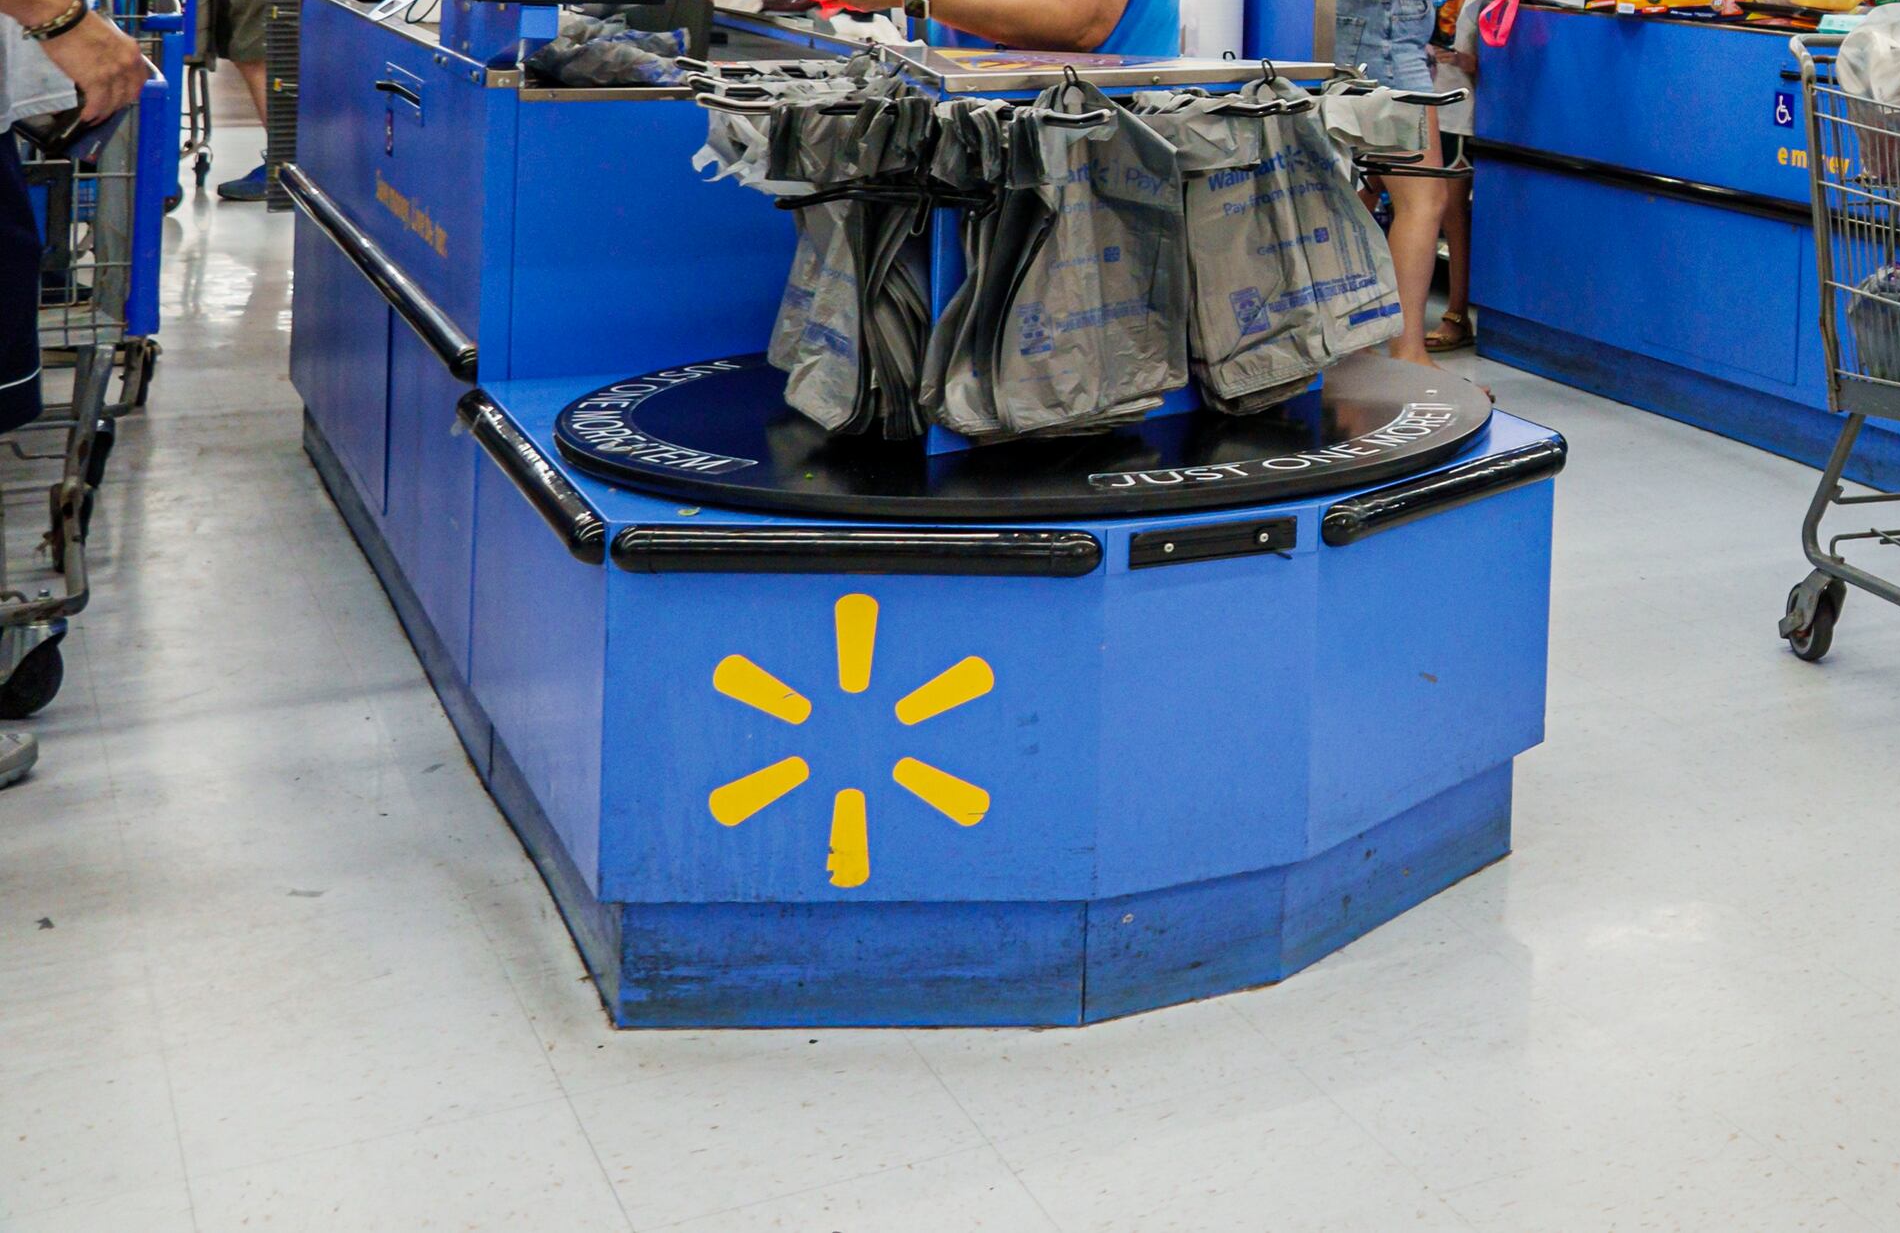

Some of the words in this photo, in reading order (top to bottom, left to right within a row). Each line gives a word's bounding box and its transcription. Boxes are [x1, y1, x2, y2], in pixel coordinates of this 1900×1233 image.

[578, 383, 658, 410] ONE
[1111, 463, 1250, 488] JUST
[1261, 443, 1382, 470] ONE
[1360, 411, 1452, 447] MORE
